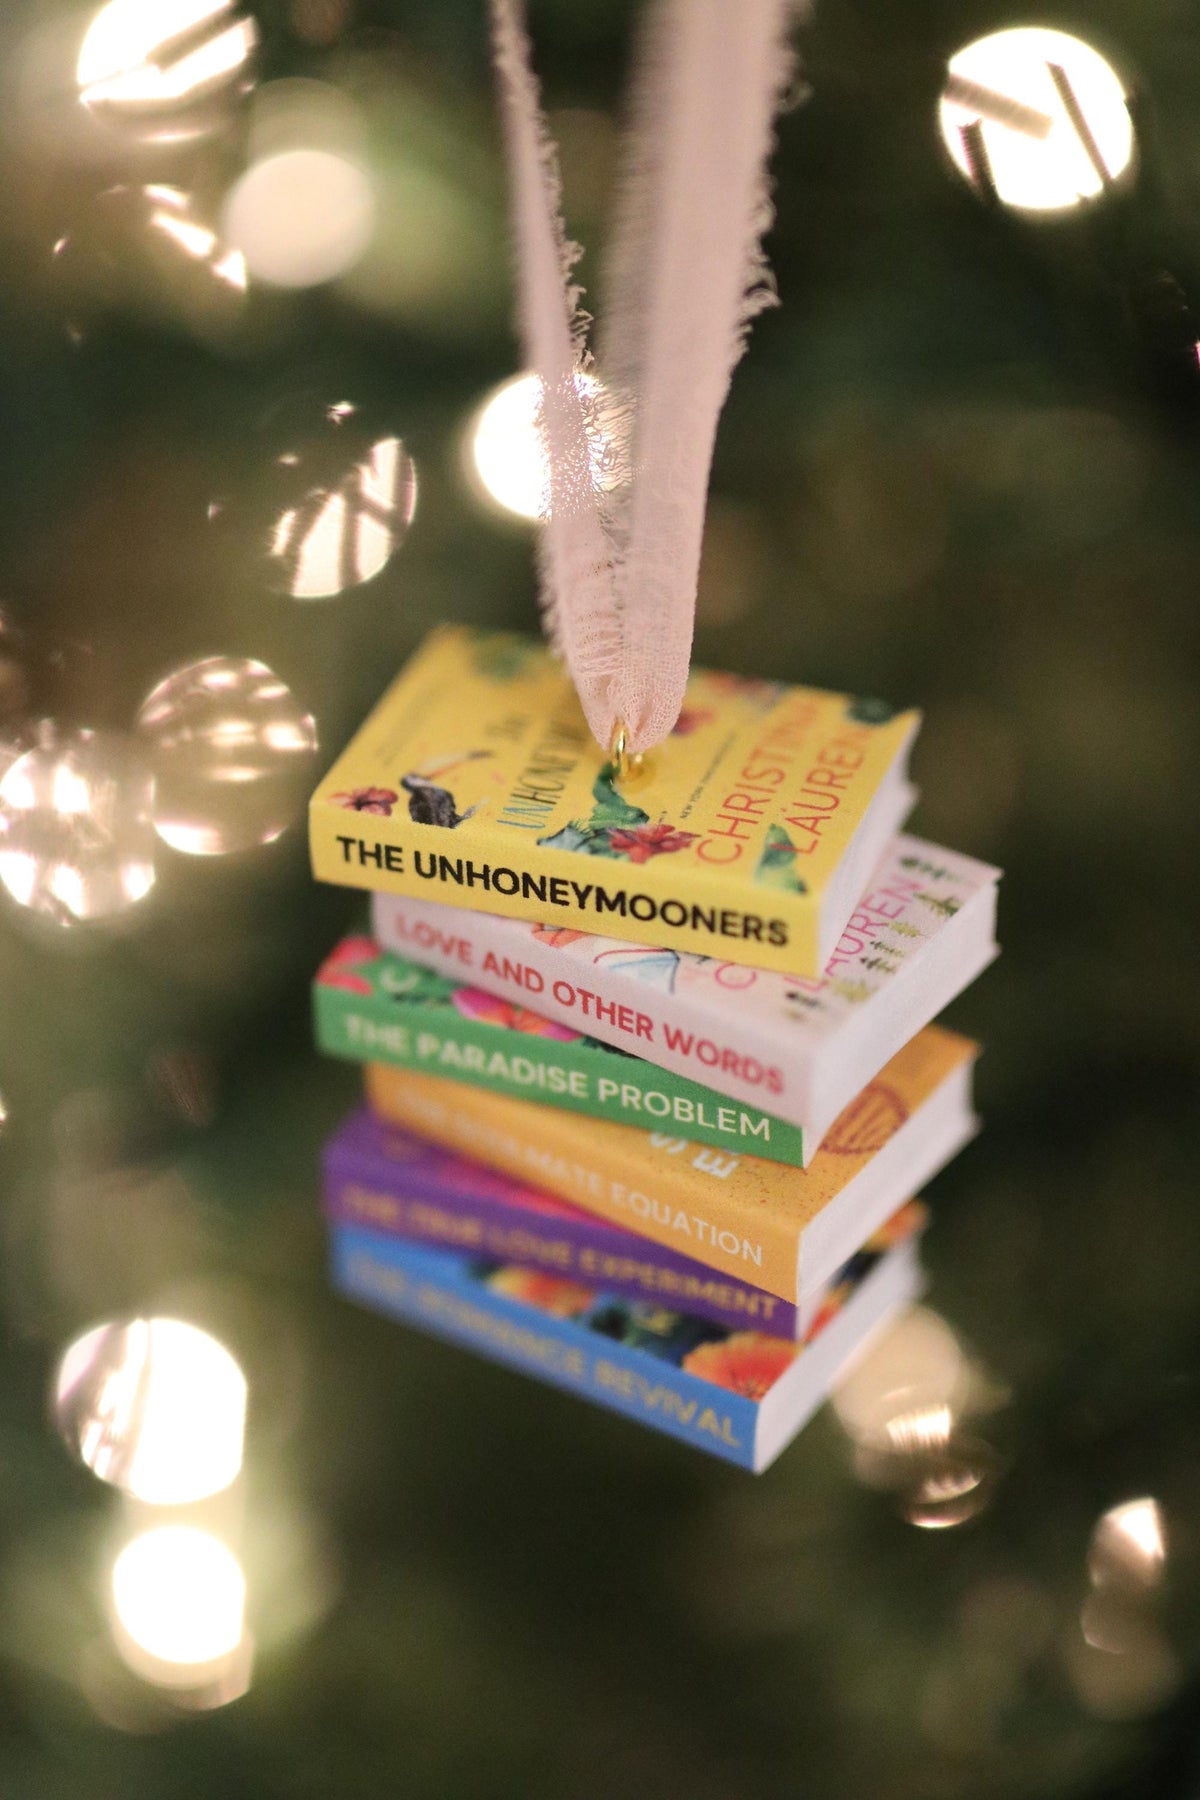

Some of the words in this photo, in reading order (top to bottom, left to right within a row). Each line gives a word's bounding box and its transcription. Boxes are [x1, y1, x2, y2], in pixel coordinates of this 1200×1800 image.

[336, 836, 404, 873] THE
[414, 850, 788, 947] UNHONEYMOONERS
[395, 912, 473, 966] LOVE
[481, 951, 545, 994] AND
[552, 981, 653, 1042] OTHER
[662, 1022, 785, 1096] WORDS
[345, 1014, 409, 1055] THE
[416, 1035, 589, 1098] PARADISE
[598, 1078, 770, 1142] PROBLEM
[611, 1182, 763, 1266] EQUATION
[579, 1248, 777, 1320] EXPERIMENT
[595, 1358, 741, 1447] REVIVAL
